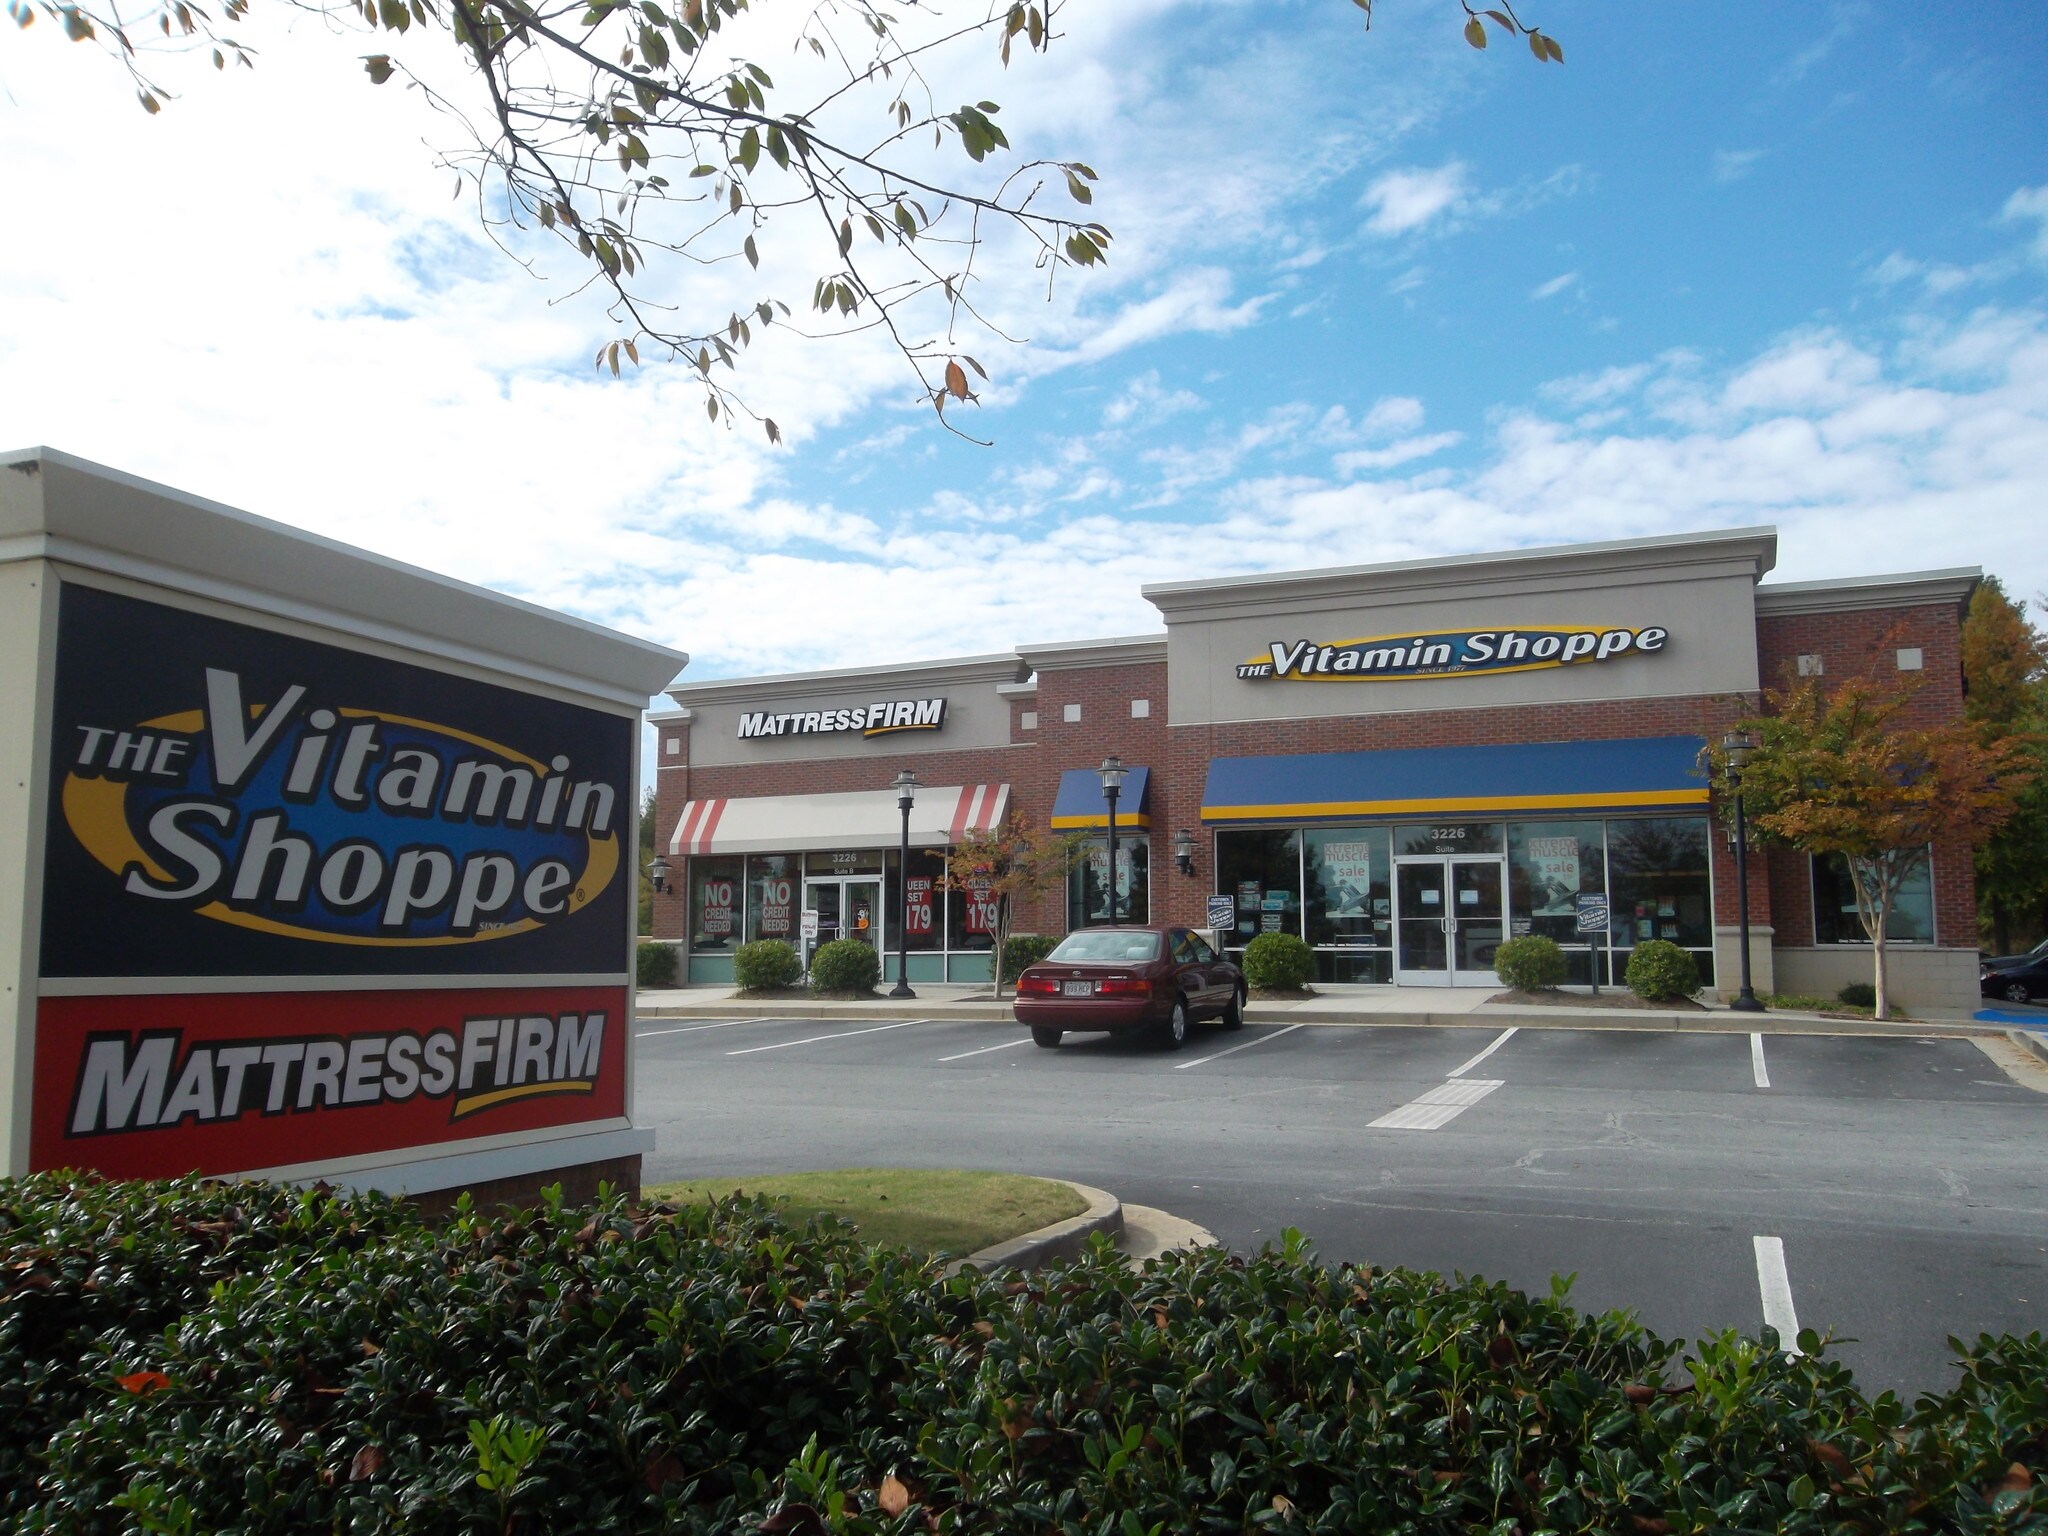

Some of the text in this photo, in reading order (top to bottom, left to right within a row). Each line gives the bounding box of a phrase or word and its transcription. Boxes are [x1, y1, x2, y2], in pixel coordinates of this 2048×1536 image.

[1238, 627, 1667, 677] THE Vitamin Shoppe
[1415, 666, 1444, 675] SINCE
[76, 667, 617, 834] THE Vitamin
[1431, 828, 1466, 839] 3226
[1435, 845, 1455, 853] Suite
[1530, 847, 1579, 857] muscle
[832, 853, 857, 863] 3226
[1325, 851, 1369, 862] muscle
[125, 802, 568, 927] Shoppe
[1546, 861, 1574, 873] sale
[1339, 865, 1365, 877] sale
[907, 880, 930, 891] UEEN
[967, 879, 991, 889] QUEE
[704, 883, 732, 907] NO
[762, 881, 791, 905] NO
[907, 892, 924, 902] SET
[973, 890, 990, 900] SET
[705, 907, 731, 920] CREDIT
[763, 906, 790, 919] CREDIT
[906, 904, 932, 930] 179
[704, 920, 731, 933] NEEDED
[762, 919, 790, 932] NEEDED
